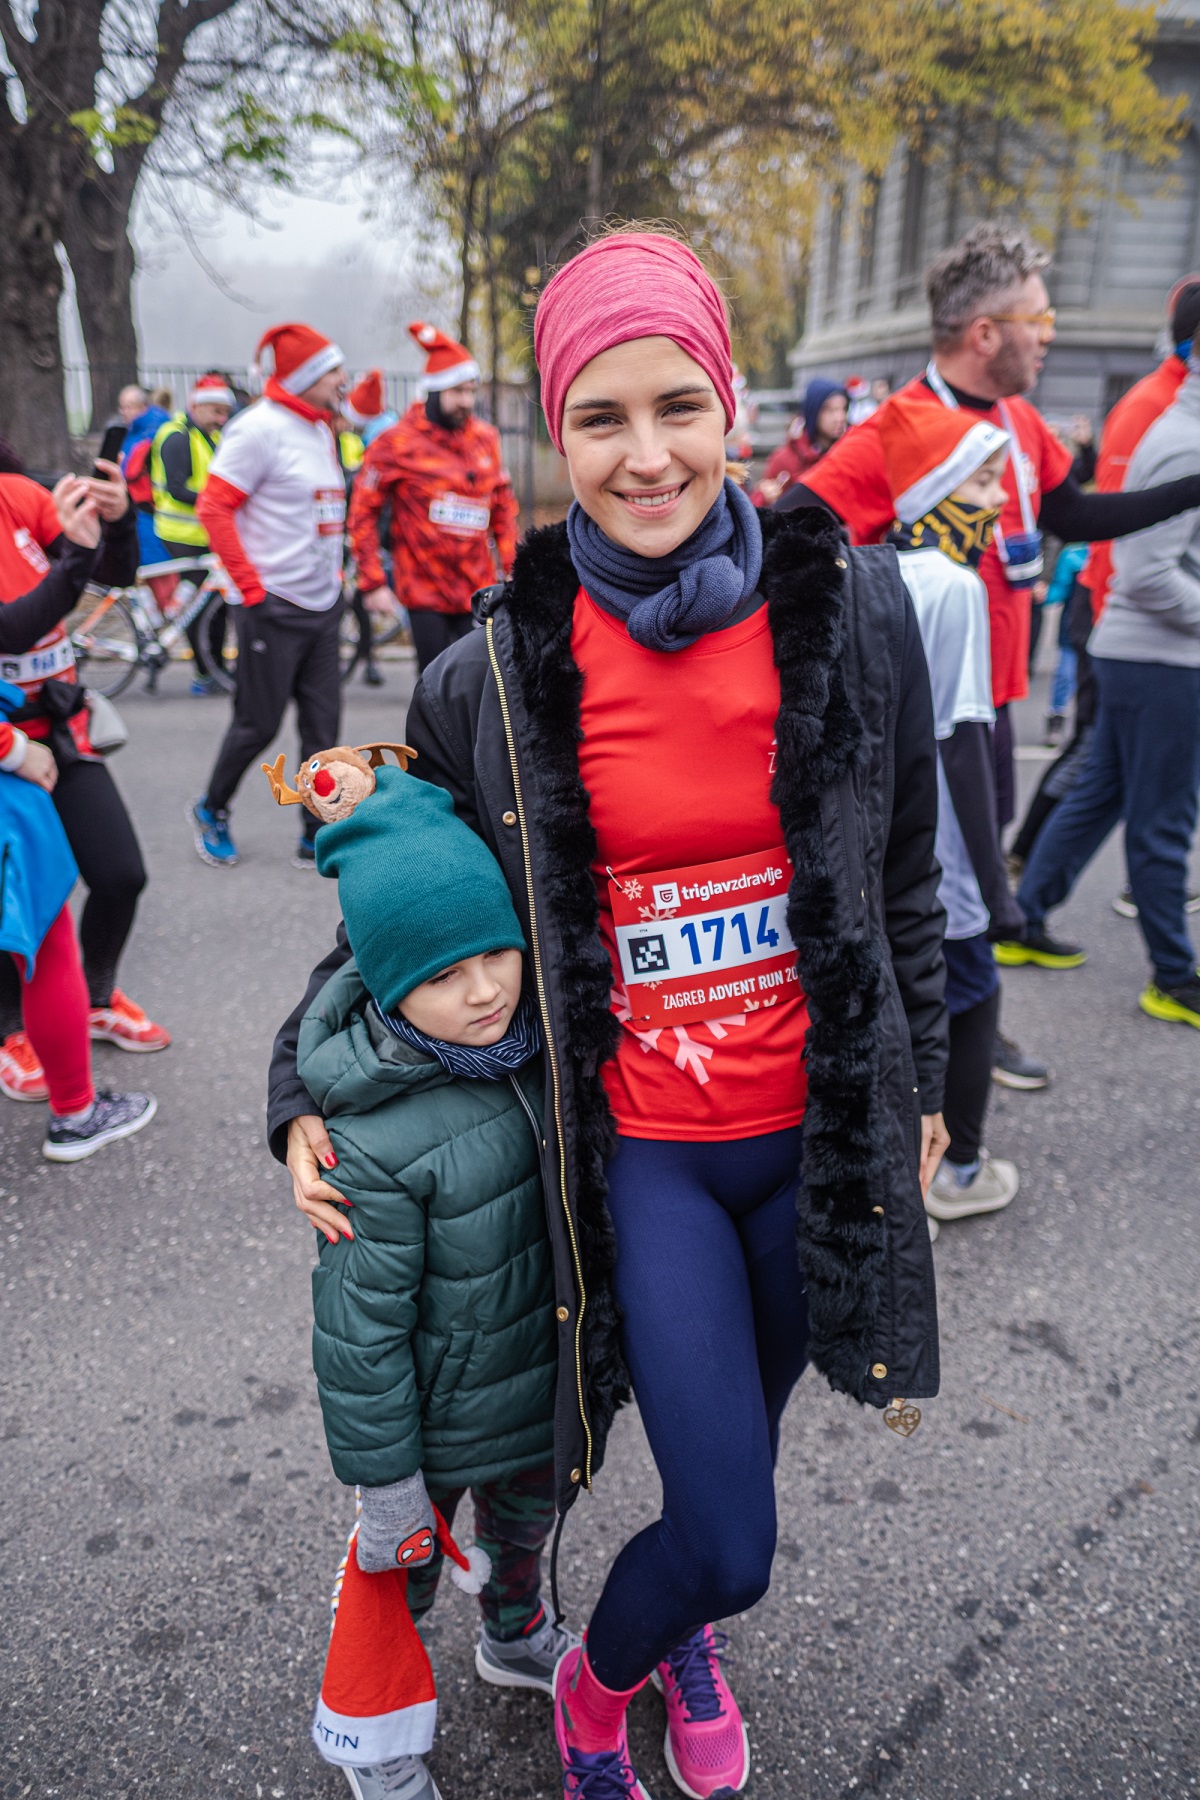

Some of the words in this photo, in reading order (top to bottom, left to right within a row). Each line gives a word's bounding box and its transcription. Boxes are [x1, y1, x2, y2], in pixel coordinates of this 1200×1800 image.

[681, 867, 783, 902] triglavzdravlje
[680, 906, 780, 966] 1714
[662, 989, 706, 1010] ZAGREB
[708, 977, 756, 1003] ADVENT
[757, 969, 784, 991] RUN
